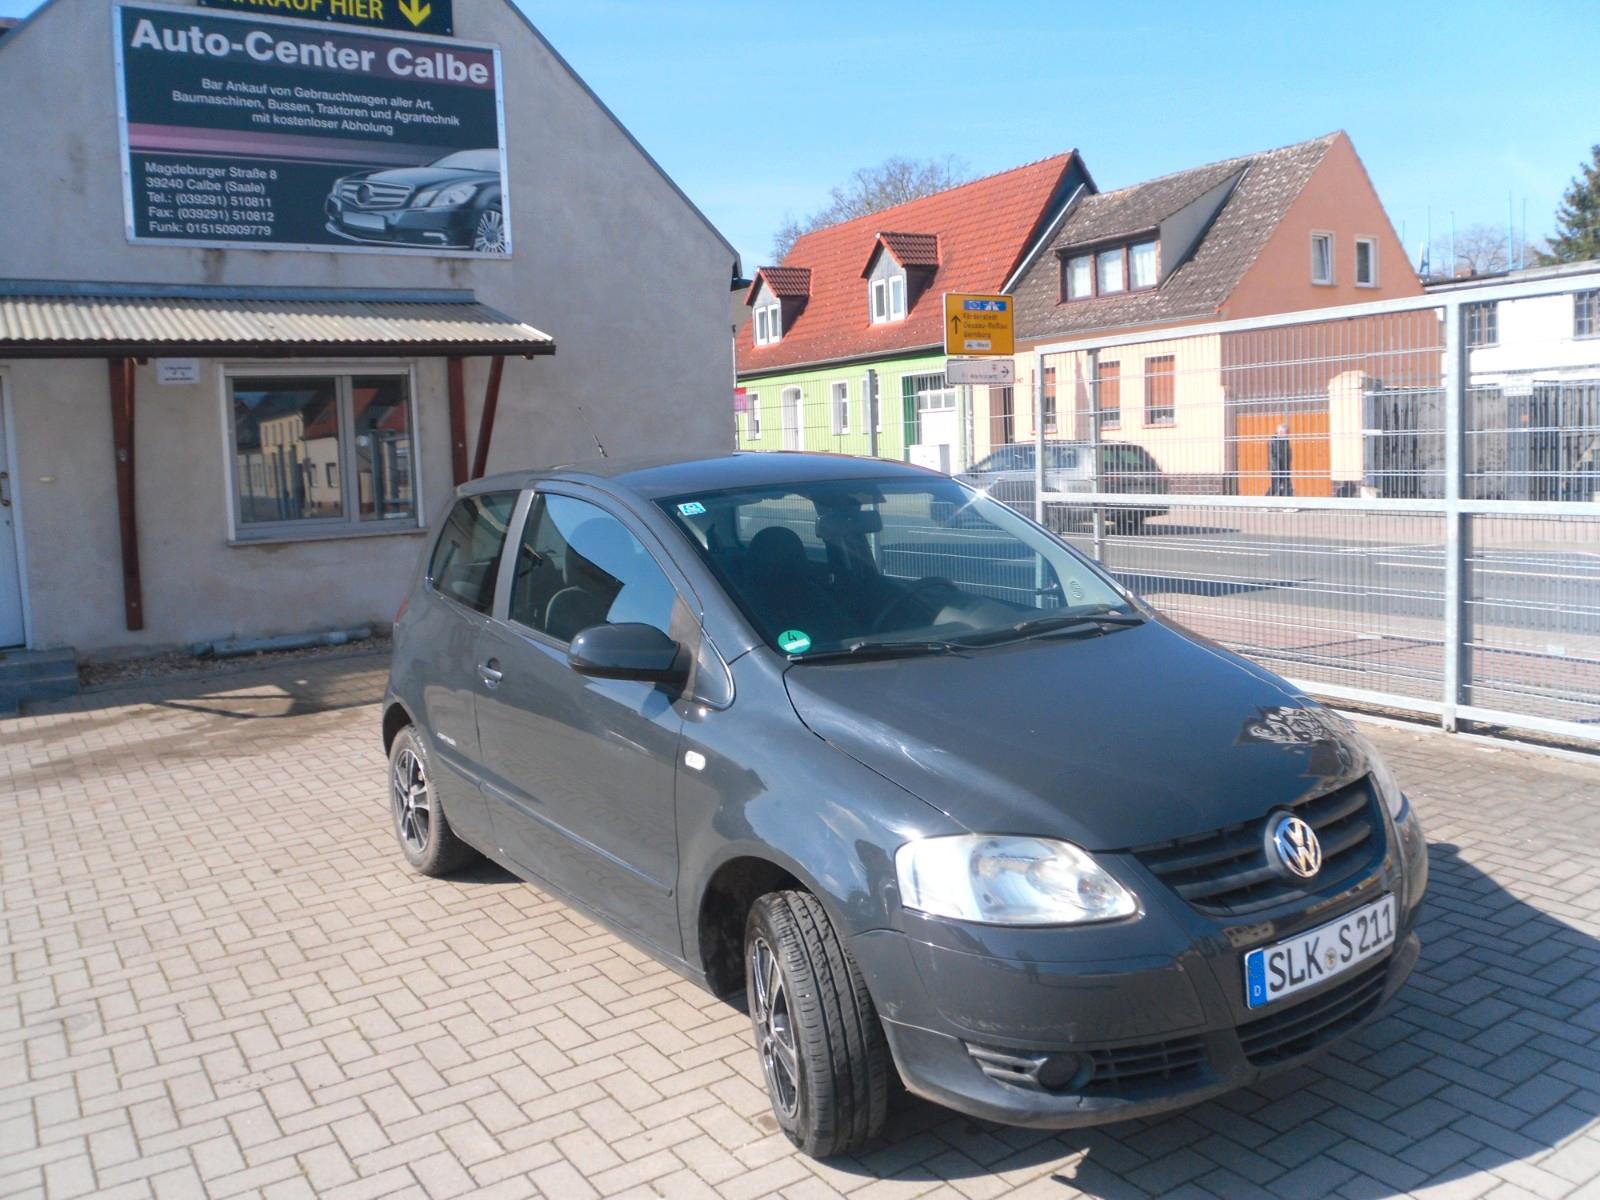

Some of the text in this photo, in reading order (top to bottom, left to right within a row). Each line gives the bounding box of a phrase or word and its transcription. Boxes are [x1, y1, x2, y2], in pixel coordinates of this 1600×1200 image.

[330, 0, 384, 20] HIER
[131, 18, 489, 84] Auto-Center Calbe
[202, 78, 434, 111] Bar Ankauf von Gebrauchtwagen aller Art,
[172, 90, 460, 126] Baumaschinen, Bussen, Traktoren und Agrartechnik
[252, 113, 394, 136] mit kostenloser Abholung
[145, 162, 226, 178] Magdeburger
[229, 166, 267, 179] Straße
[145, 177, 265, 195] 39240 Calbe (Saale)
[175, 192, 227, 207] (039291)
[230, 196, 271, 207] 510811
[148, 206, 275, 222] Fax: (039291) 510812
[149, 221, 183, 233] Funk:
[1269, 936, 1324, 992] SLK
